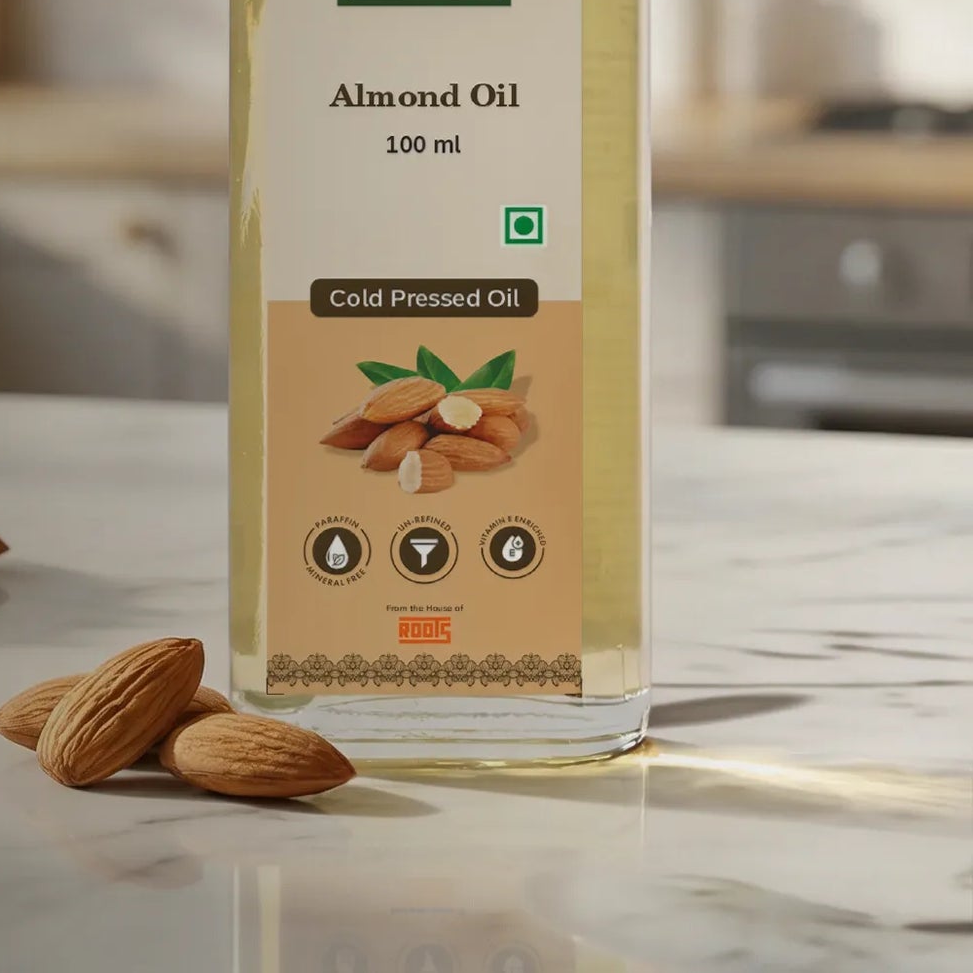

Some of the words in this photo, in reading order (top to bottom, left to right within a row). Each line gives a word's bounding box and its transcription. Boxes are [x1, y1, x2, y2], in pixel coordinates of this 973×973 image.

[329, 83, 461, 107] Almond
[470, 83, 520, 107] Oil
[386, 134, 426, 154] 100
[433, 134, 461, 154] ml
[329, 288, 383, 308] Cold
[390, 288, 480, 308] Pressed
[487, 288, 520, 308] Oil
[314, 516, 360, 529] PARAFFIN
[397, 515, 452, 533] UN-REFINED
[479, 516, 506, 547] VITAMIN
[514, 515, 547, 547] ENRICHED
[306, 565, 345, 587] MINERAL
[346, 567, 367, 585] FREE
[386, 604, 408, 612] From
[410, 604, 424, 612] the
[426, 604, 453, 612] House
[454, 604, 464, 612] of
[398, 616, 451, 644] ROOTS
